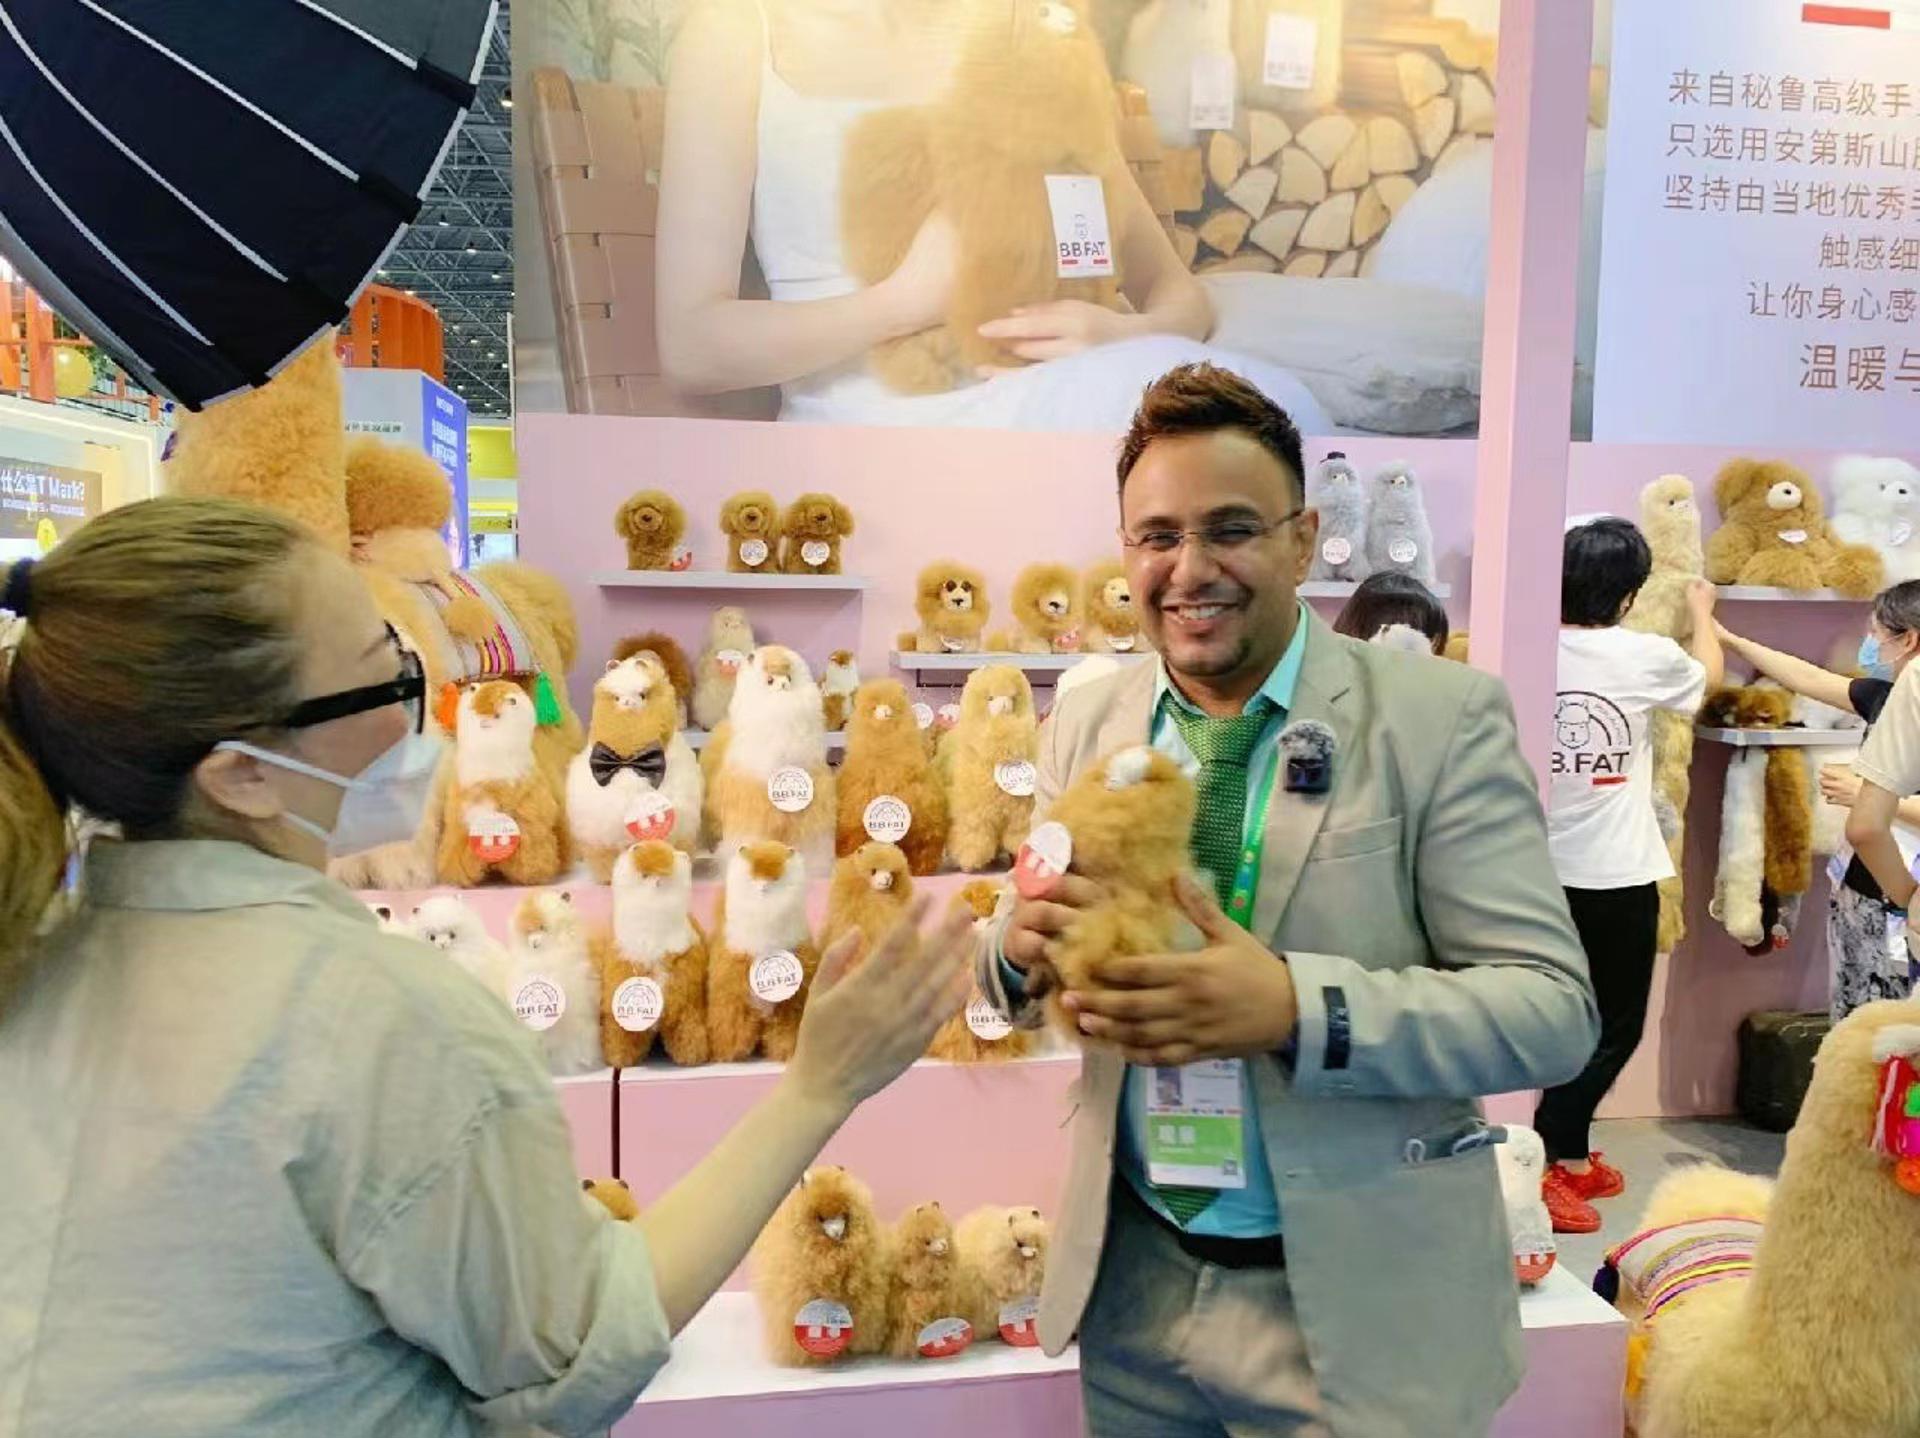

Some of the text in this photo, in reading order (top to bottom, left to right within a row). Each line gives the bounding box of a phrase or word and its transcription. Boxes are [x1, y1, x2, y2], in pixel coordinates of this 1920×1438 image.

[1668, 68, 1920, 118] 来自秘鲁高级手
[1819, 232, 1919, 271] 触感细
[1747, 281, 1918, 322] 让你身心感
[1799, 343, 1920, 392] 温暖与
